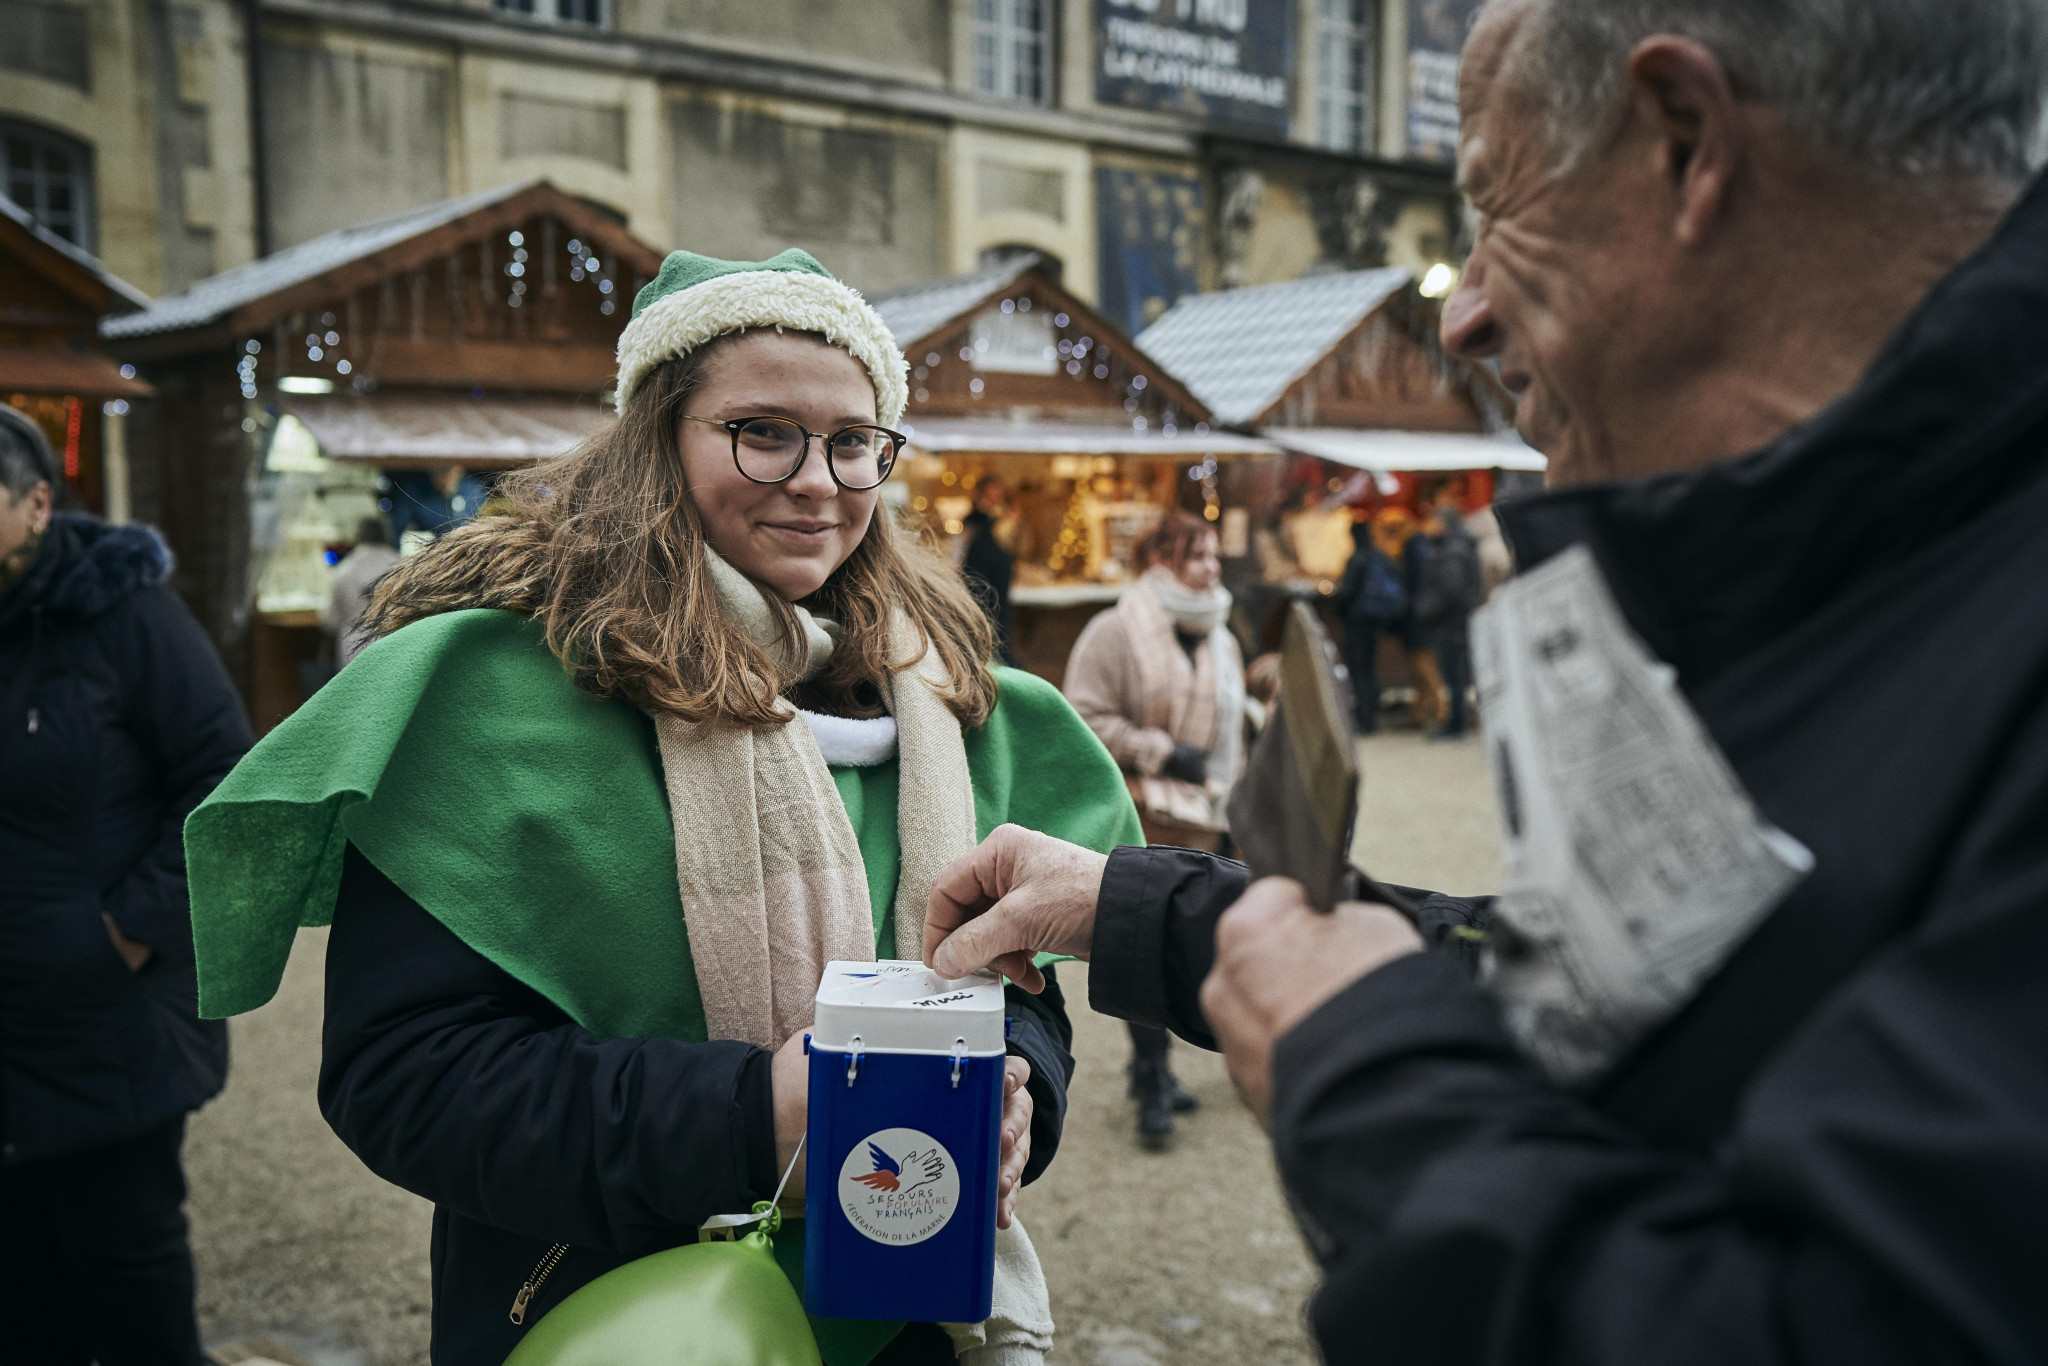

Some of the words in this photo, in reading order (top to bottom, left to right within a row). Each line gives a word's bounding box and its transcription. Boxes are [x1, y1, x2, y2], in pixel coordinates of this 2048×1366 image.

[1105, 47, 1138, 77] LA
[867, 1188, 934, 1205] SECOURS
[886, 1196, 948, 1210] POPULAIRE
[875, 1205, 934, 1219] FRANÇAIS
[846, 1202, 889, 1240] FÉDÉRATION
[891, 1233, 903, 1241] DE
[906, 1231, 917, 1240] LA
[919, 1213, 946, 1237] MARNE
